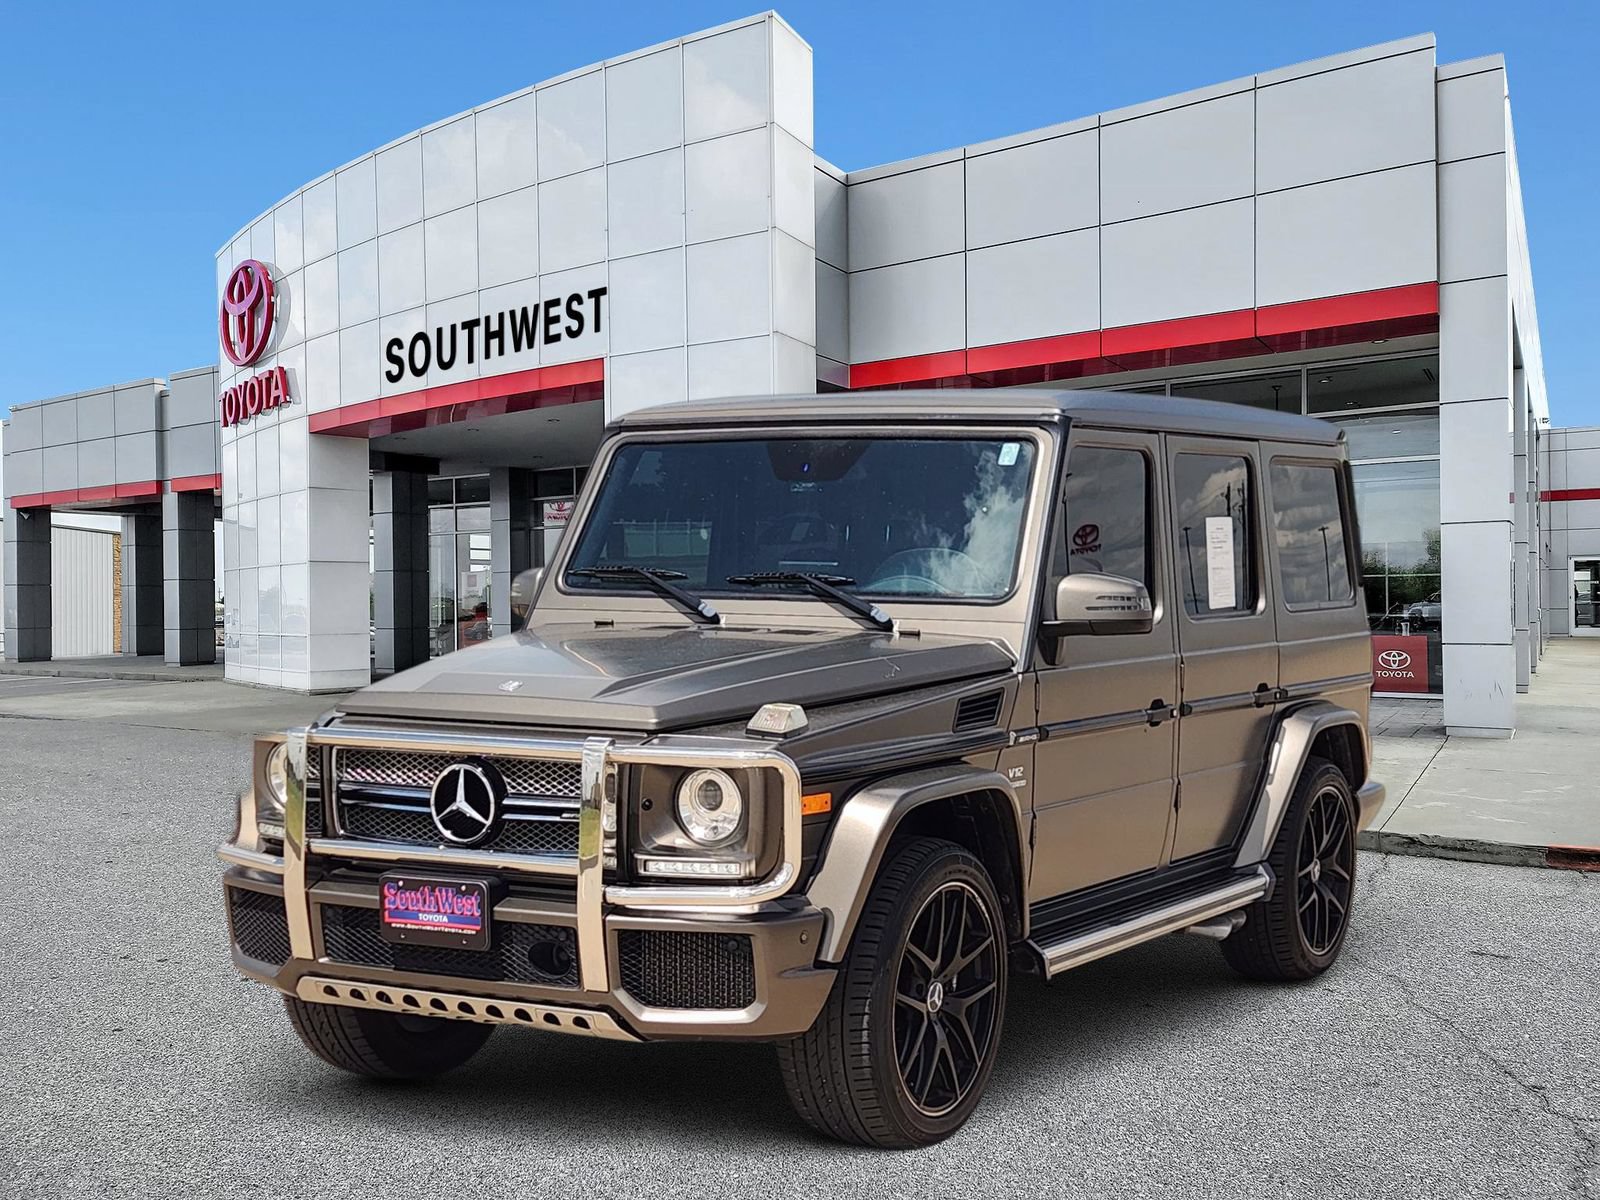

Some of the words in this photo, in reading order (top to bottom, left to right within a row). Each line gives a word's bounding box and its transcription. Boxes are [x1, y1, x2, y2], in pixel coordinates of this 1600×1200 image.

[385, 286, 608, 384] SOUTHWEST
[218, 366, 291, 428] TOYOTA
[1375, 670, 1415, 678] TOYOTA
[1008, 766, 1024, 778] V12
[418, 913, 448, 923] TOYOTA
